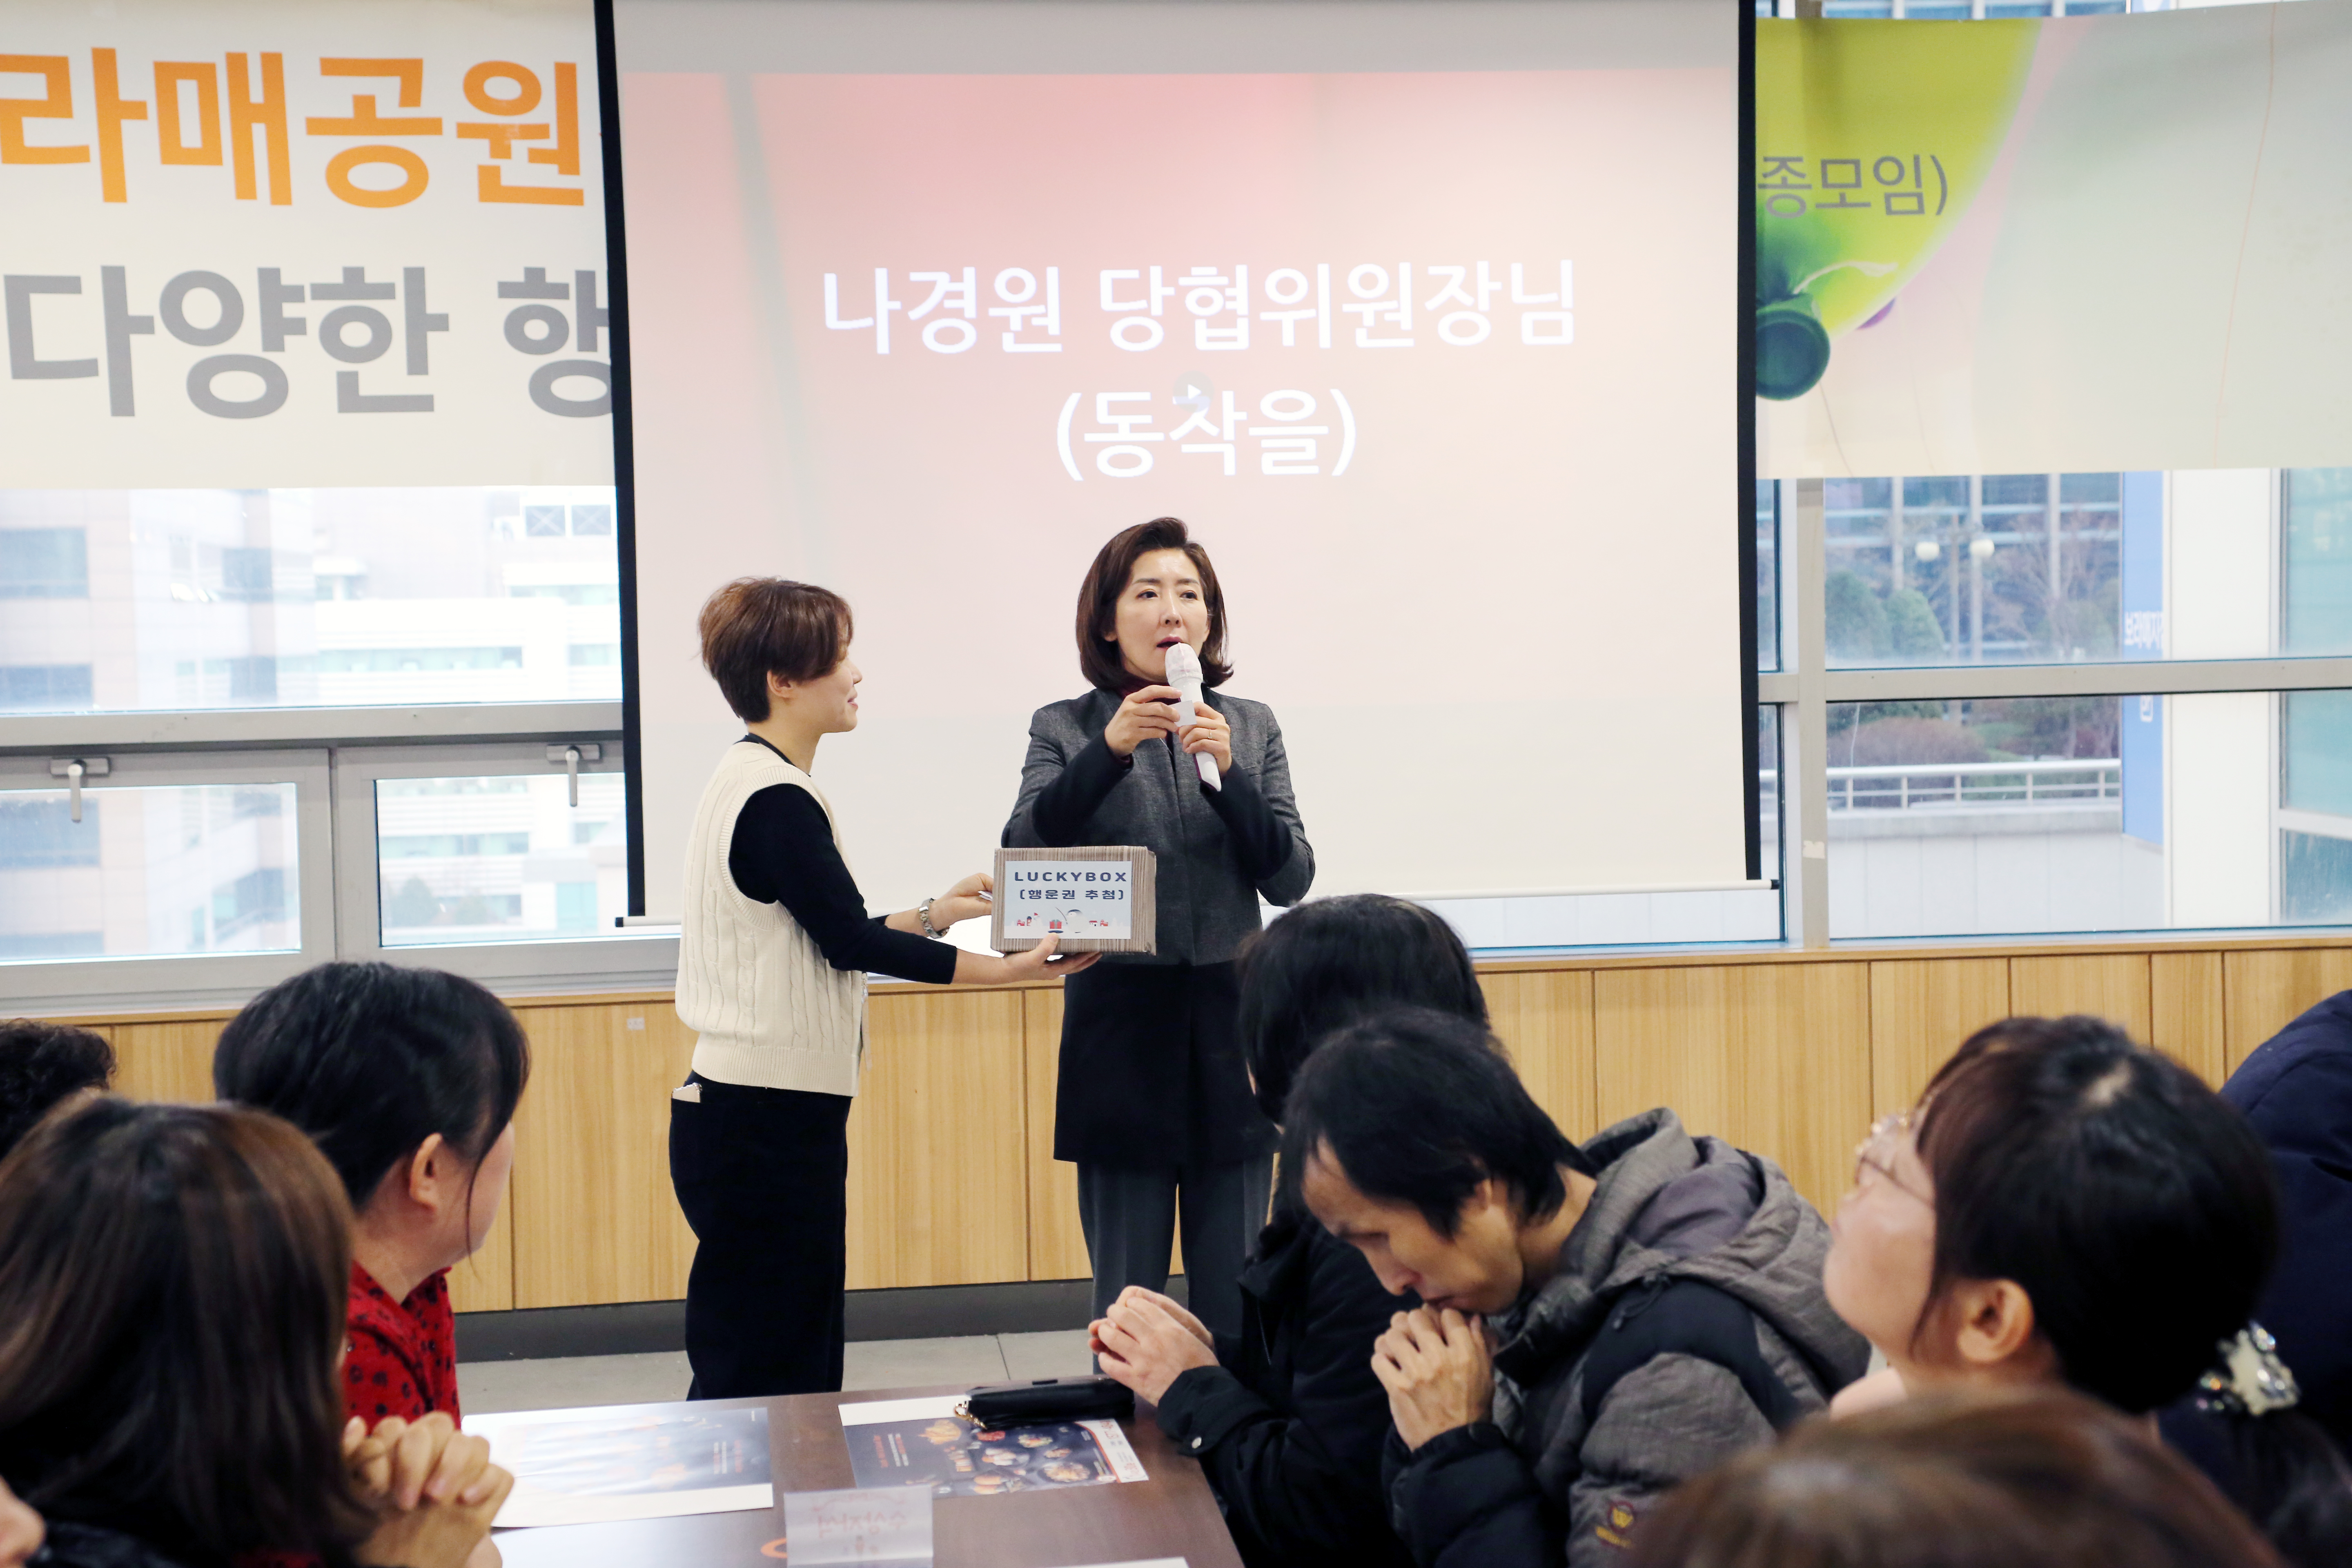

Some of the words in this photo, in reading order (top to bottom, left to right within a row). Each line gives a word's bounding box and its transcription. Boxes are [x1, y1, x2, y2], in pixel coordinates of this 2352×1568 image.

[0, 47, 584, 208] 라매공원
[1757, 154, 1948, 219] 종모임)
[4, 265, 449, 419] 다양한
[824, 266, 1062, 354] 나경원
[1099, 259, 1575, 352] 당협위원장님
[1056, 384, 1357, 481] (동작을)
[1015, 872, 1127, 882] LUCKYBOX
[1085, 889, 1124, 900] 추첨)
